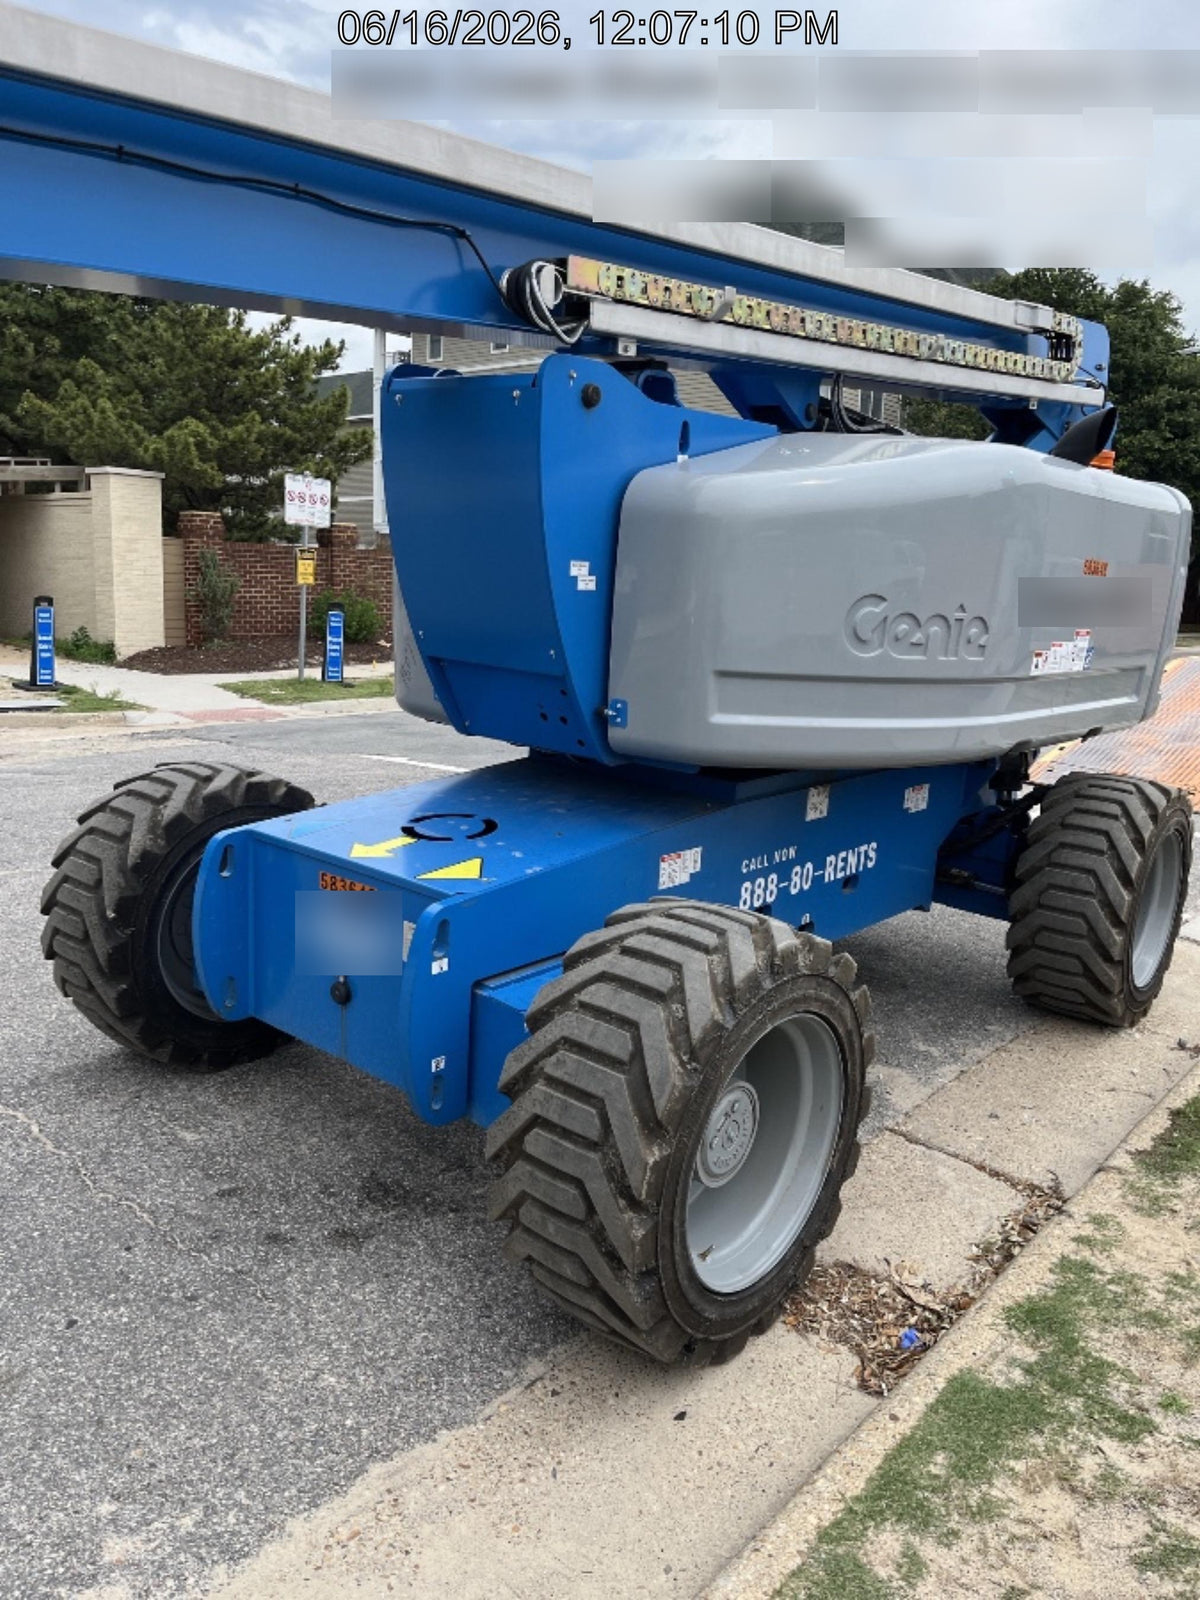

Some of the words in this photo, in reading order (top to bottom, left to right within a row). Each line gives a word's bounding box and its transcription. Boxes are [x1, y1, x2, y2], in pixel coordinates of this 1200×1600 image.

[844, 593, 990, 661] Genie
[739, 841, 878, 910] 888-80-RENTS
[741, 853, 769, 874] CALL
[773, 845, 798, 865] NOW
